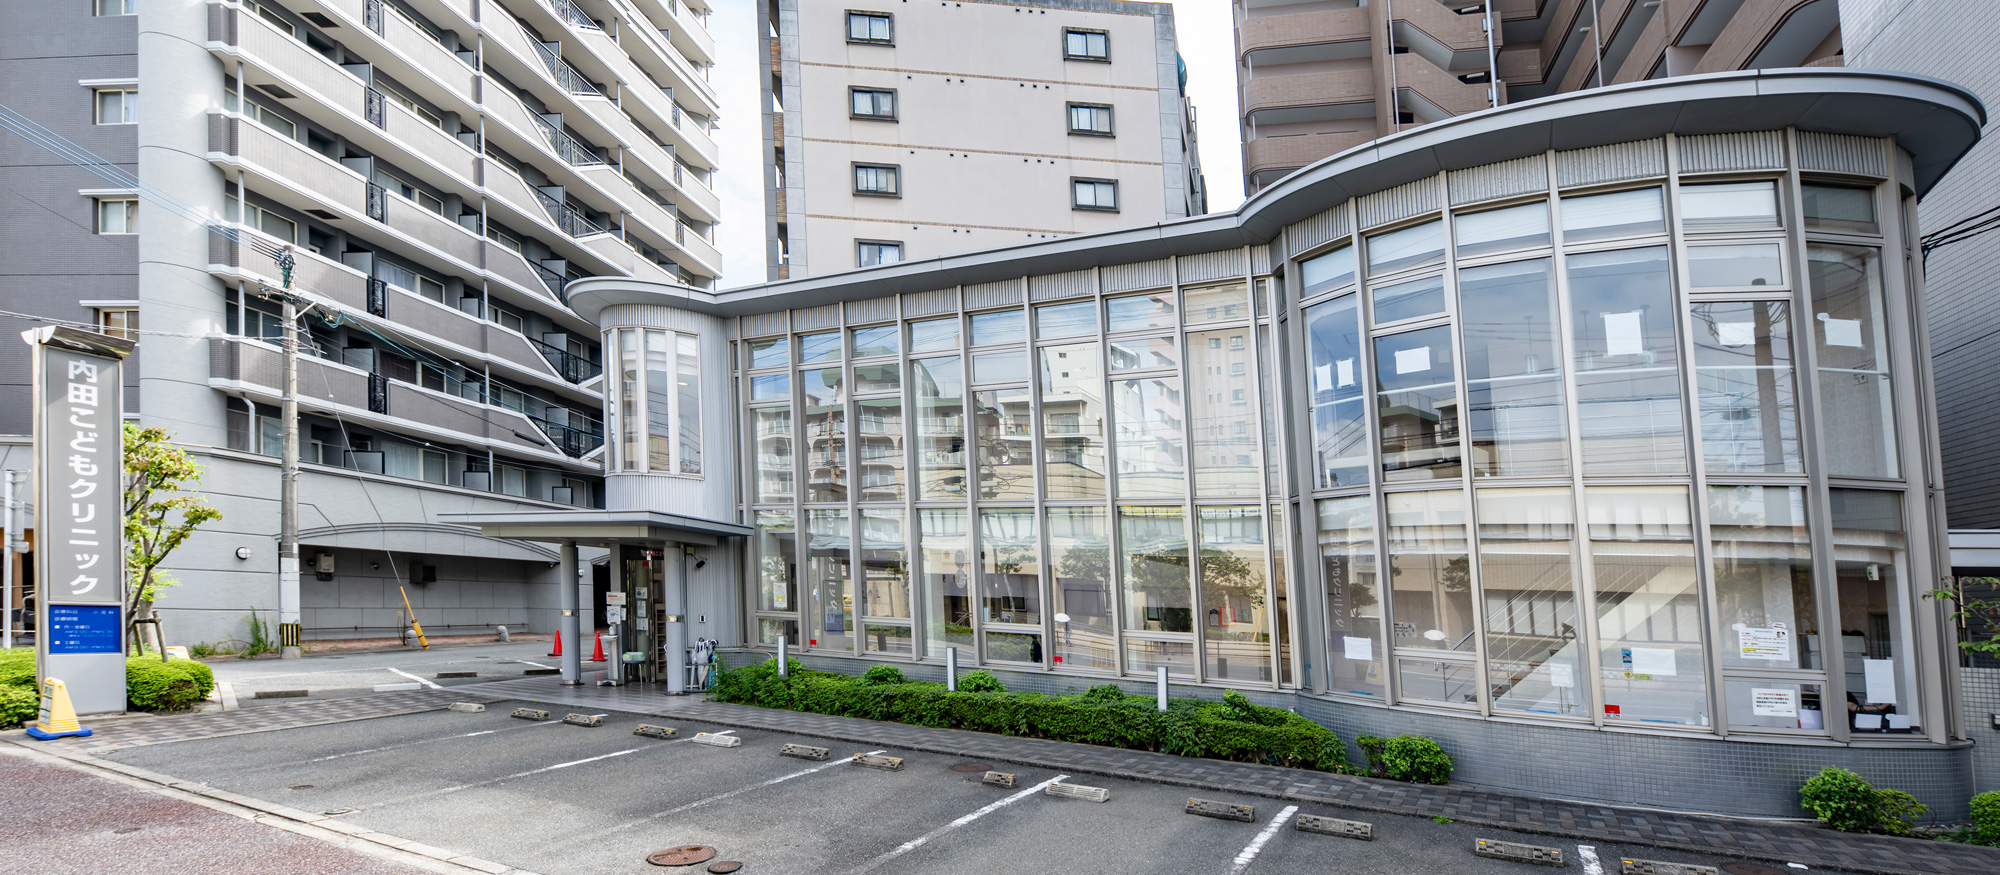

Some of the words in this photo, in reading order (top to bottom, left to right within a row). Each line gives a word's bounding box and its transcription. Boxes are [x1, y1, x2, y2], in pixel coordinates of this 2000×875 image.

[67, 359, 99, 596] 内田こどもクリニック
